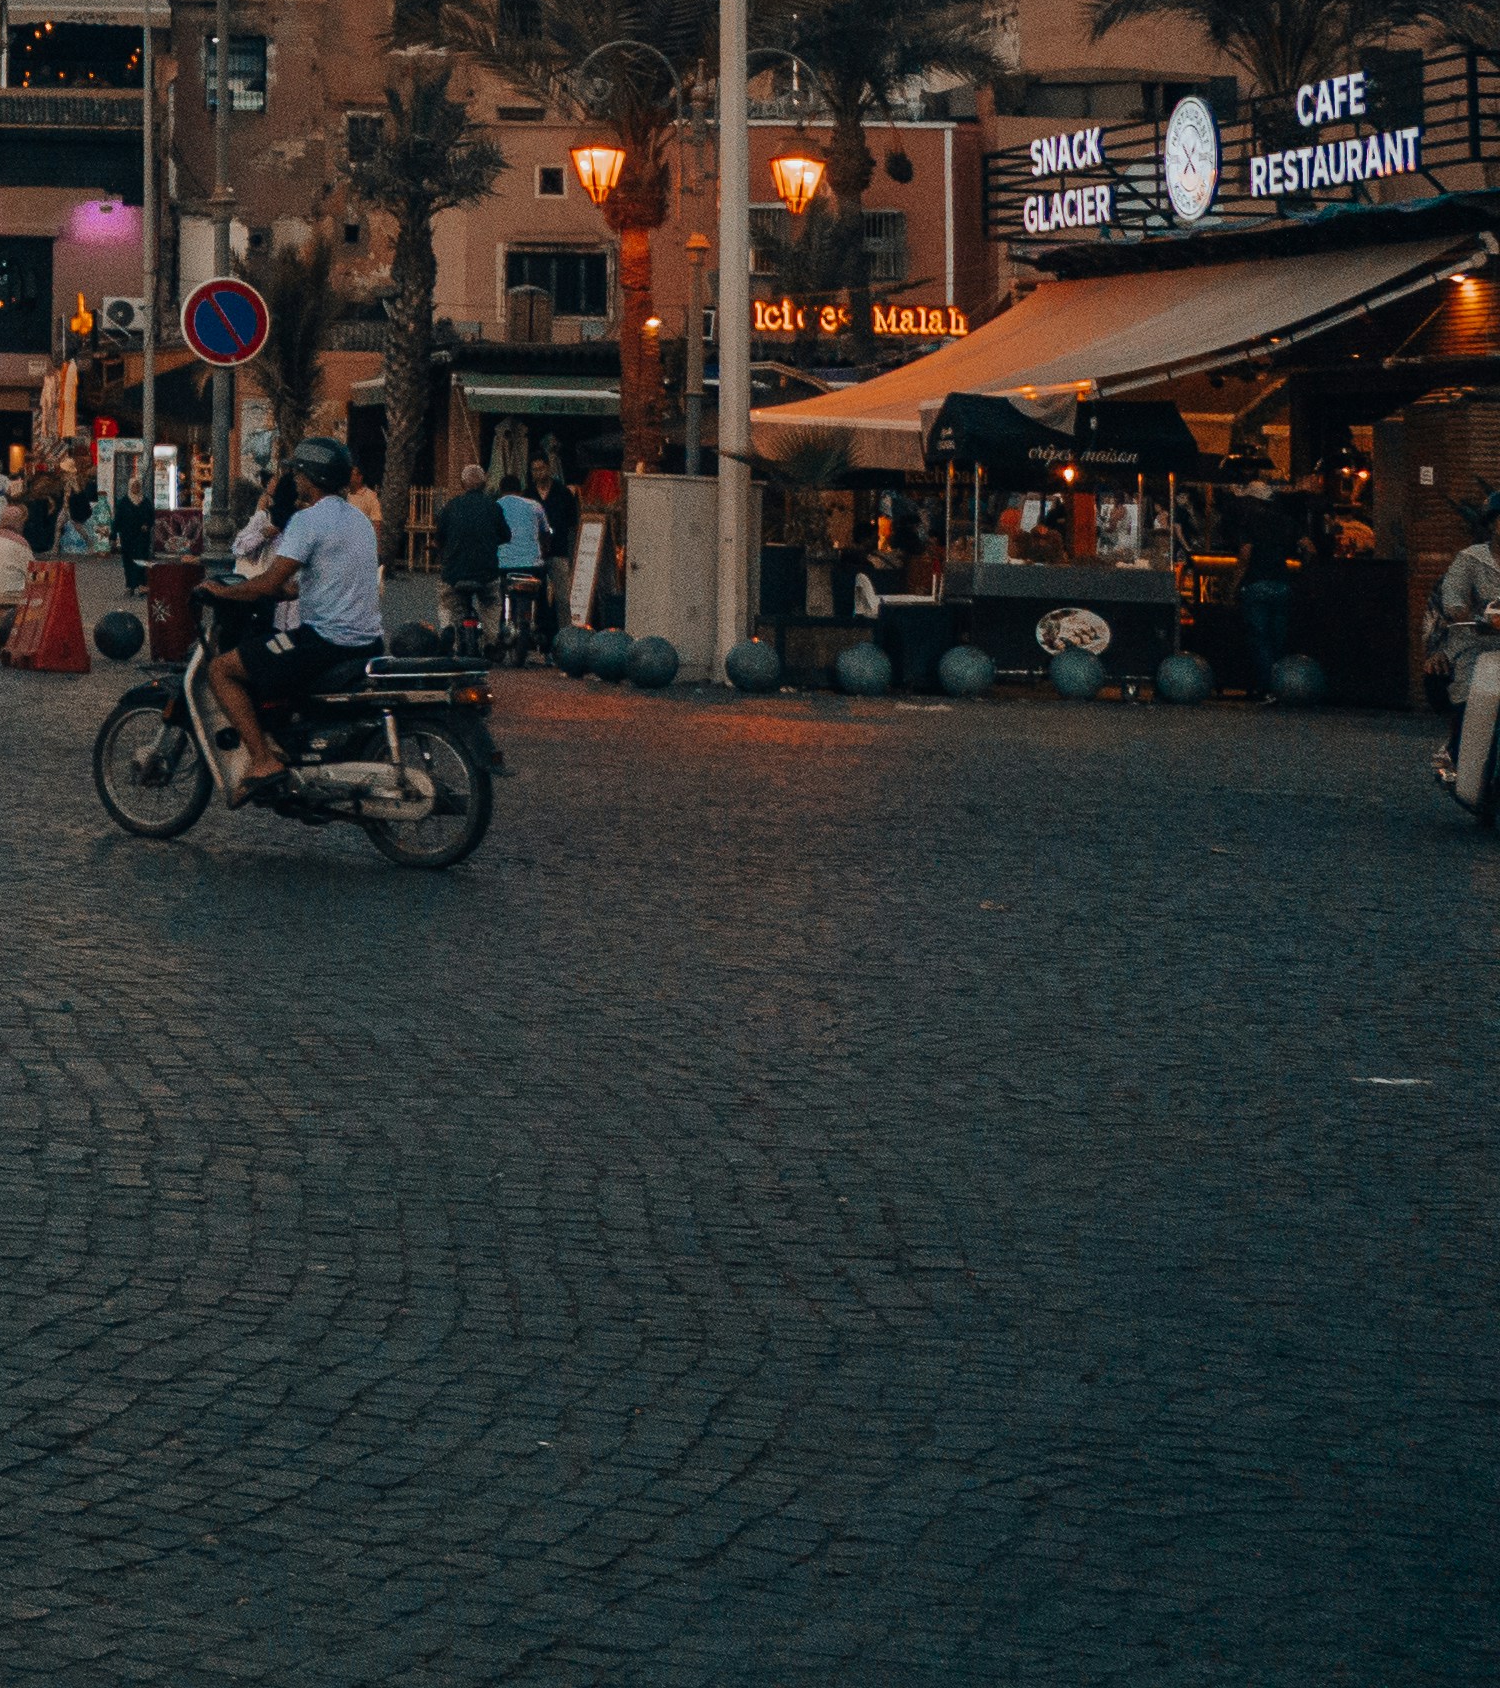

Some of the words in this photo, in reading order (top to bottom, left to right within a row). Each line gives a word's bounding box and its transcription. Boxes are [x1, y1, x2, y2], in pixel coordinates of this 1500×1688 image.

[1297, 71, 1366, 127] CAFE
[1030, 126, 1102, 177] SNACK
[1250, 126, 1420, 198] RESTAURANT
[1023, 185, 1111, 233] GLACIER
